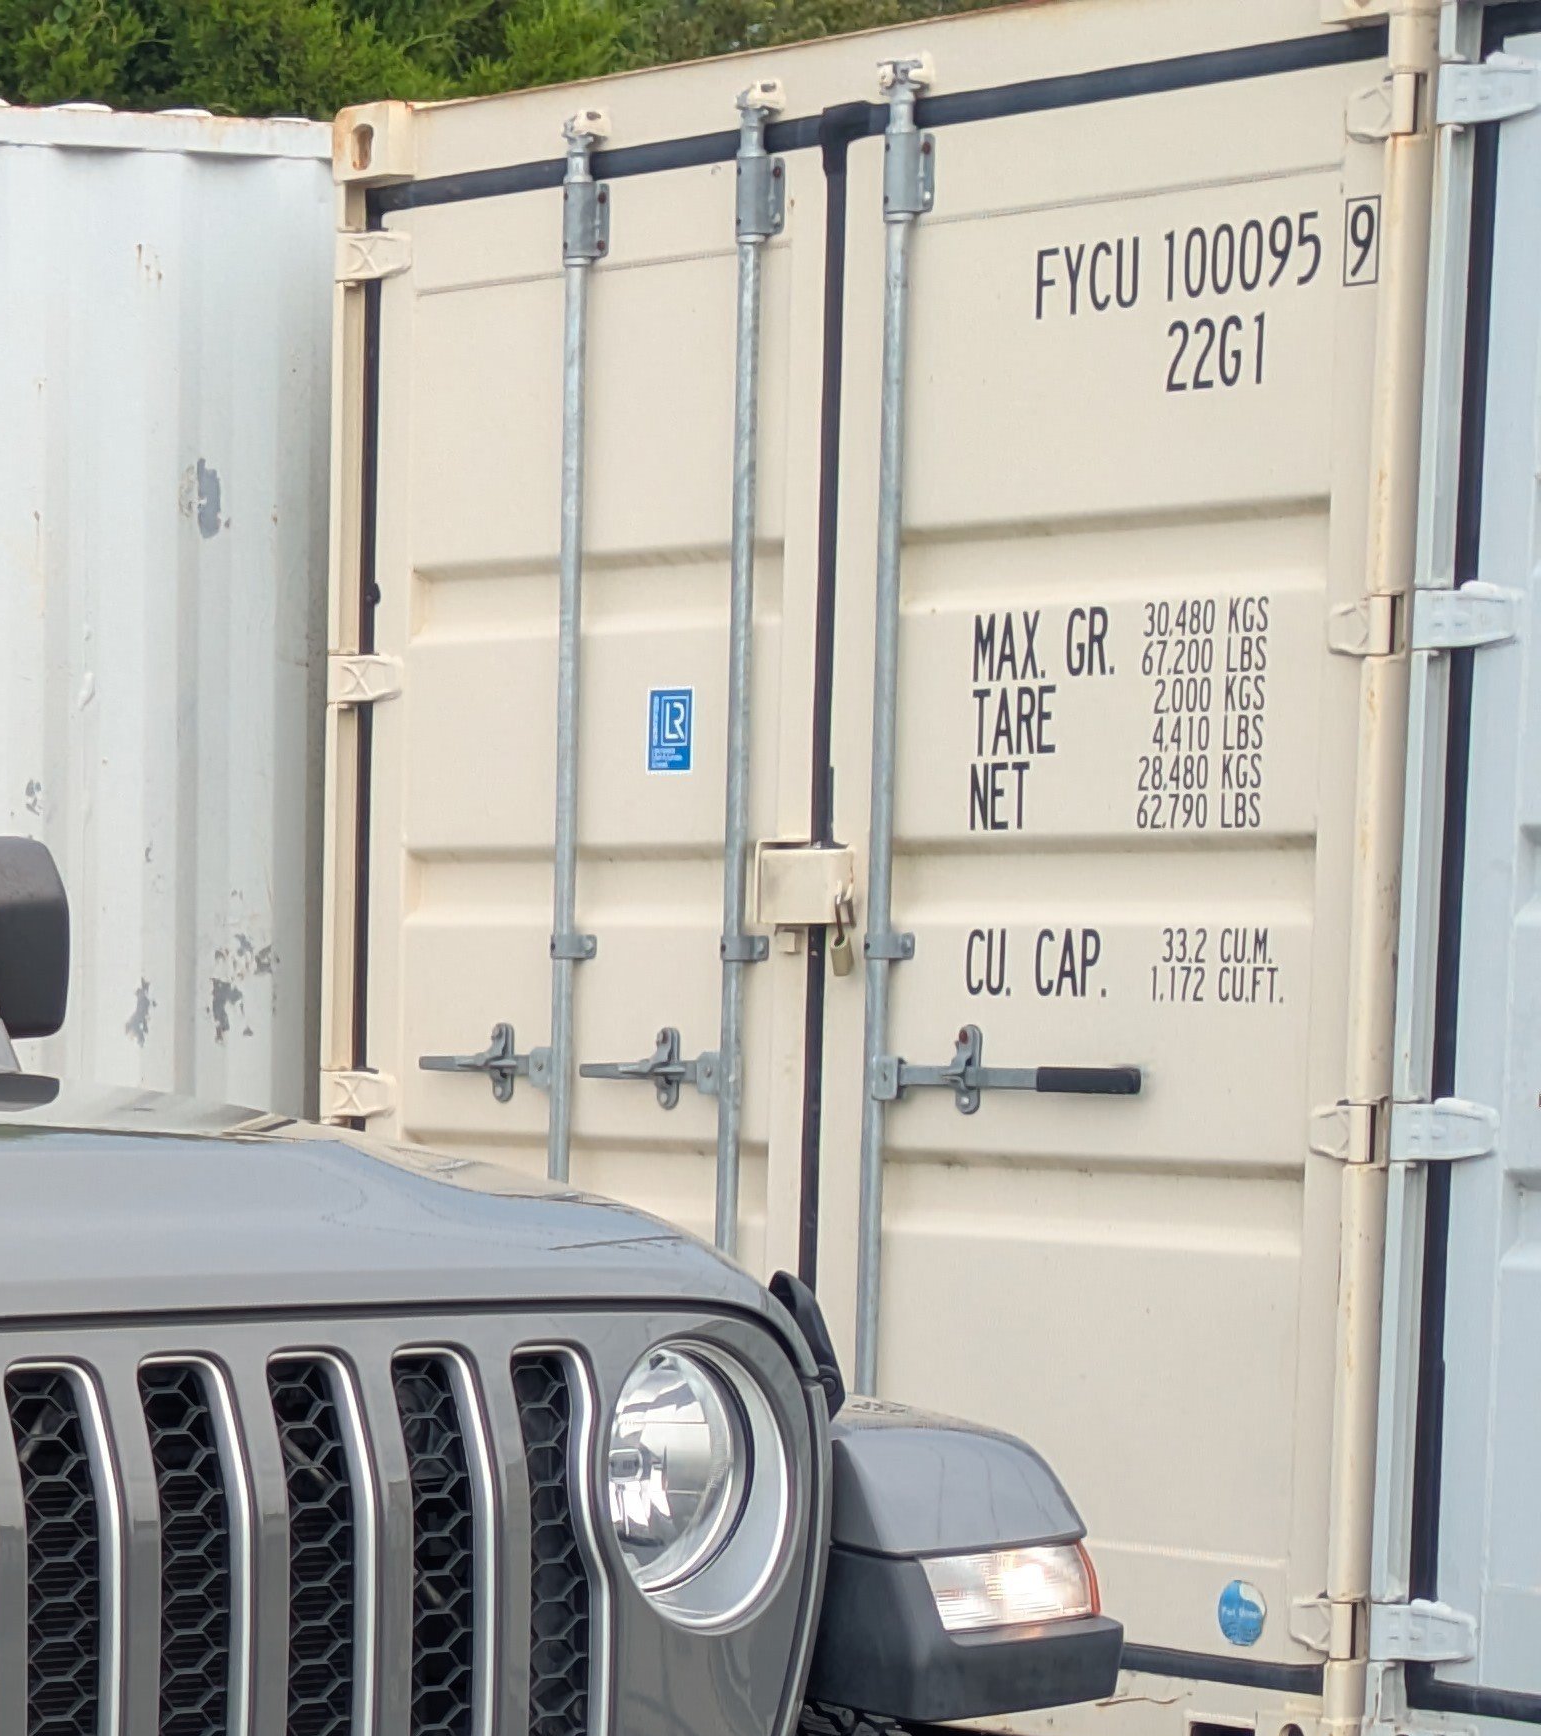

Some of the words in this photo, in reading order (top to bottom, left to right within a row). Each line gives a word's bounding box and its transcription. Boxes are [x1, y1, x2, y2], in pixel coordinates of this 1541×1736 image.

[1034, 235, 1140, 321] FYCU
[1164, 210, 1323, 303] 100095
[1349, 203, 1376, 278] 9
[1165, 311, 1266, 393] 22G1
[972, 609, 1046, 683] MAX.
[1066, 605, 1115, 677] GR.
[1228, 595, 1269, 634] KGS
[1225, 635, 1267, 673] LBS
[664, 701, 686, 740] LR
[972, 684, 1057, 757] TARE
[1224, 674, 1266, 712] KGS
[1222, 713, 1264, 751] LBS
[969, 760, 1031, 831] NET
[1221, 753, 1262, 790] KGS
[1220, 792, 1261, 829] LBS
[965, 928, 1011, 998] CU.
[1035, 928, 1107, 998] CAP.
[1162, 927, 1207, 963] 33.2
